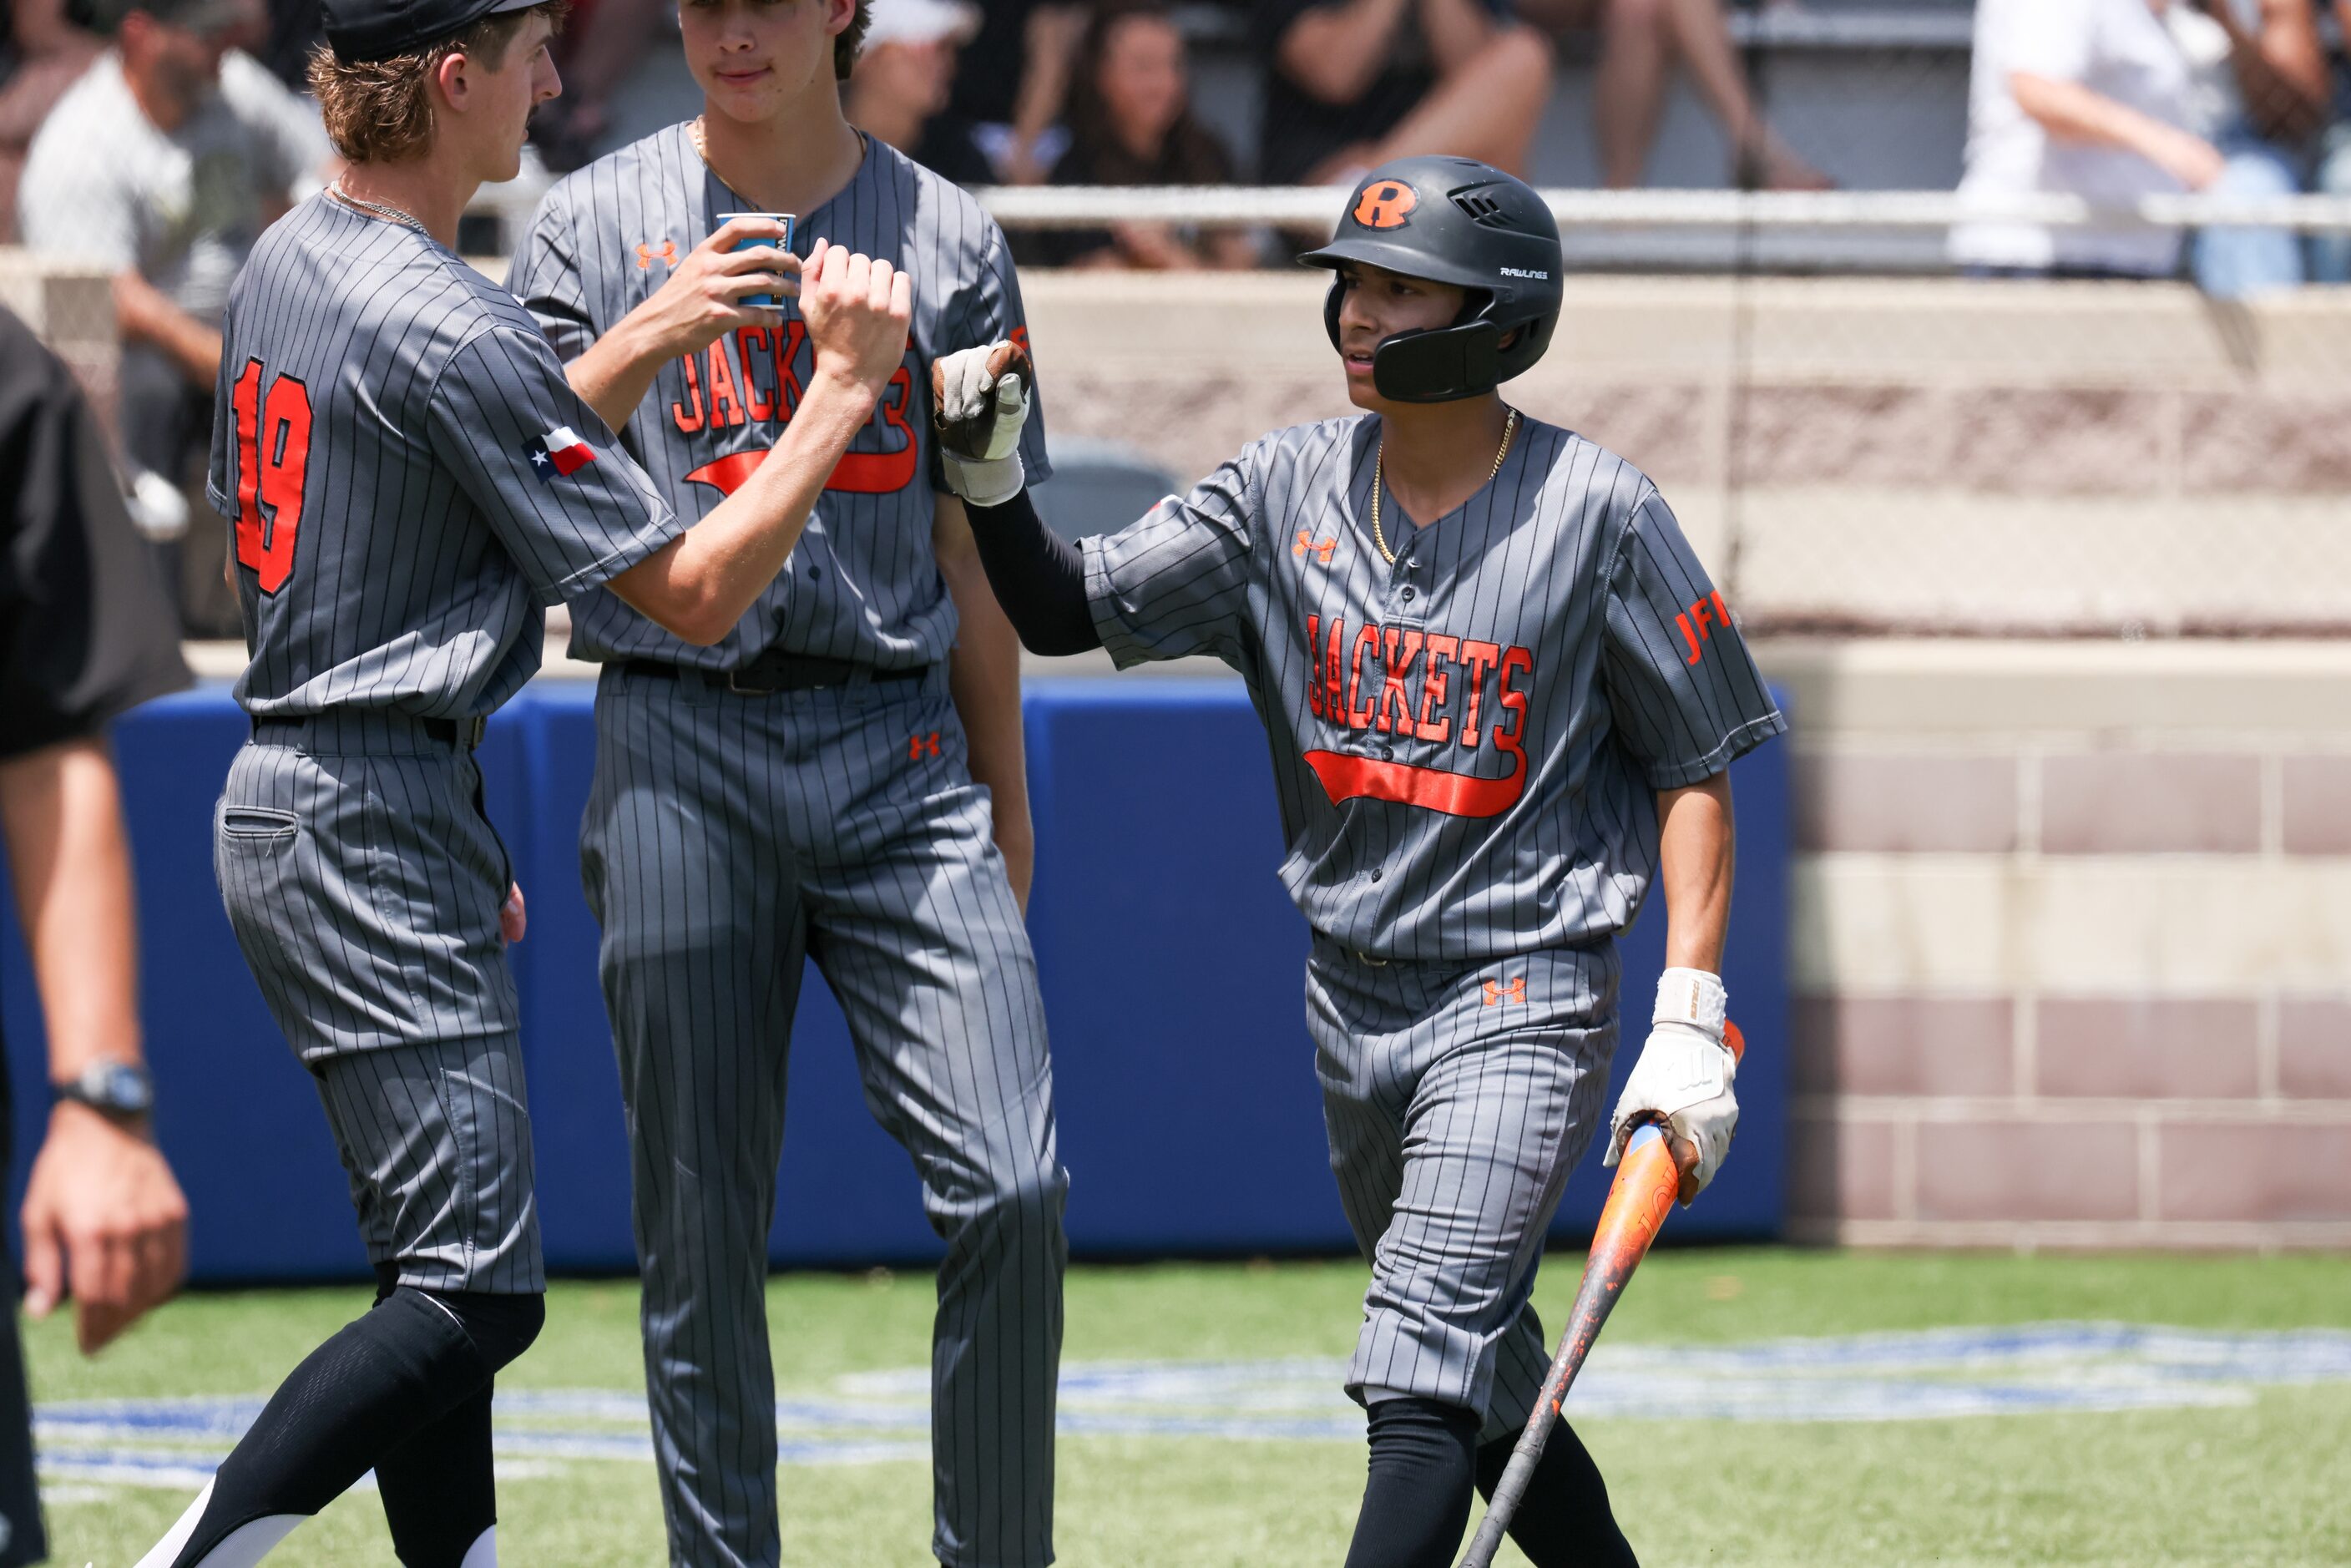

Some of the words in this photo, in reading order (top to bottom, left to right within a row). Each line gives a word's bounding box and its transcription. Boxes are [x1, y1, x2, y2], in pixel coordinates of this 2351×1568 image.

[1352, 178, 1418, 232] R
[1499, 267, 1549, 281] RAWLINGS
[232, 355, 314, 599] 19
[1307, 614, 1534, 751] JACKETS
